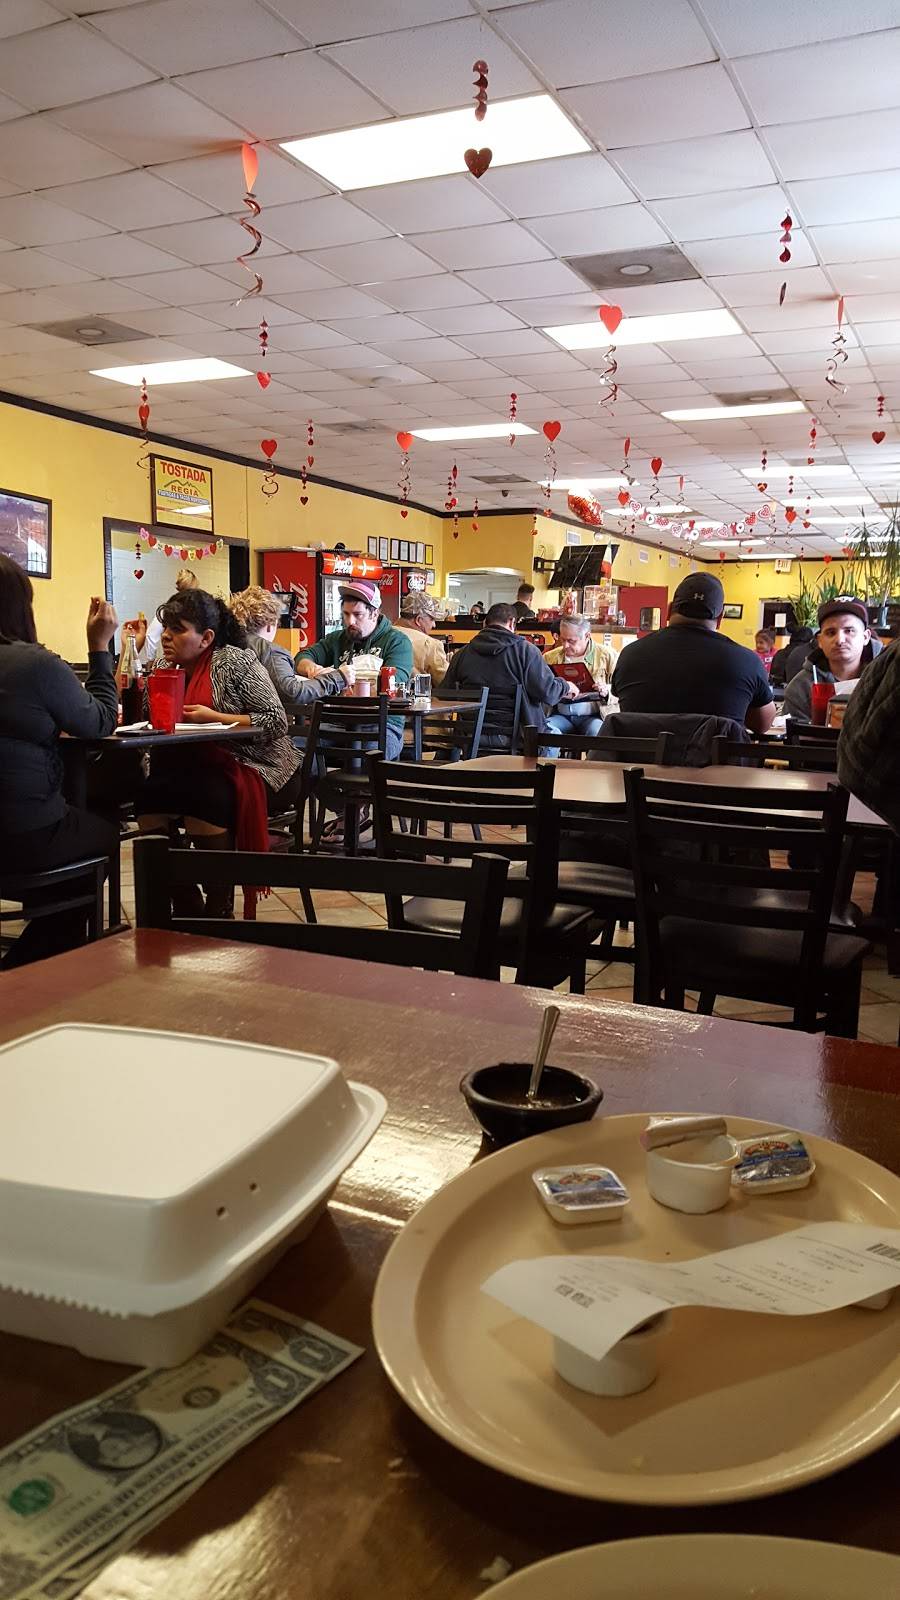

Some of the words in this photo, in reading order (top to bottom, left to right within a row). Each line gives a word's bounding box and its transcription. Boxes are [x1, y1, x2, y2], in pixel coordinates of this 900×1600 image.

[160, 461, 207, 483] TOSTADA
[171, 485, 199, 497] REGIA
[301, 1346, 324, 1359] 1
[265, 1375, 288, 1388] 1
